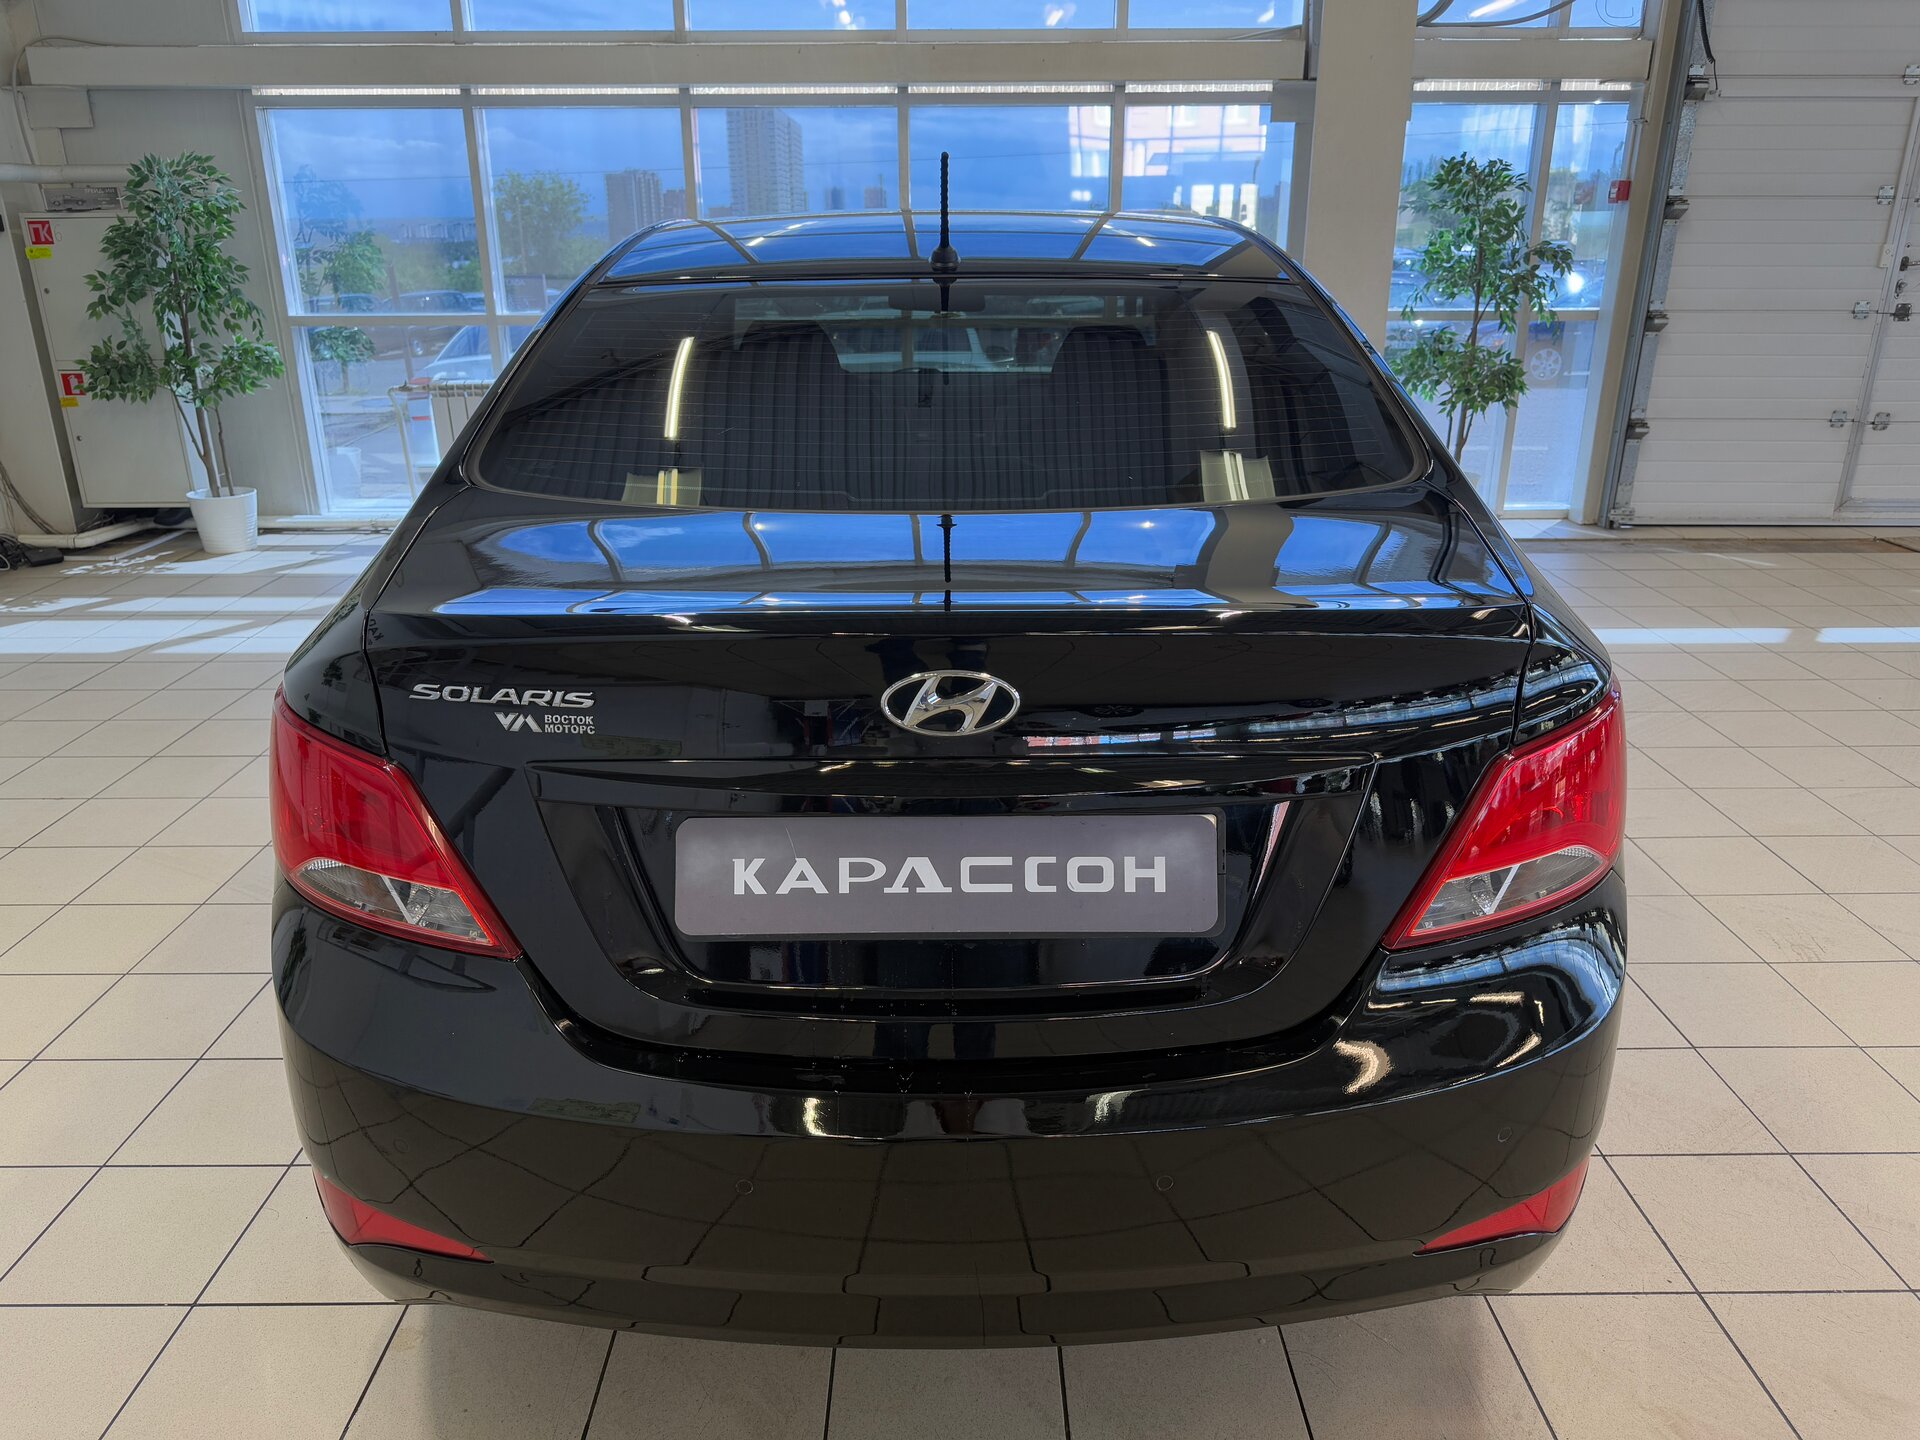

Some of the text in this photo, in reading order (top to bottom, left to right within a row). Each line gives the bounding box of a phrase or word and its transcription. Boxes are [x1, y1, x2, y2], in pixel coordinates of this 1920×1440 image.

[28, 223, 53, 242] ПК
[408, 683, 596, 709] SOLARIS
[544, 714, 594, 725] ВОСТОК
[544, 724, 596, 735] МОТОРС
